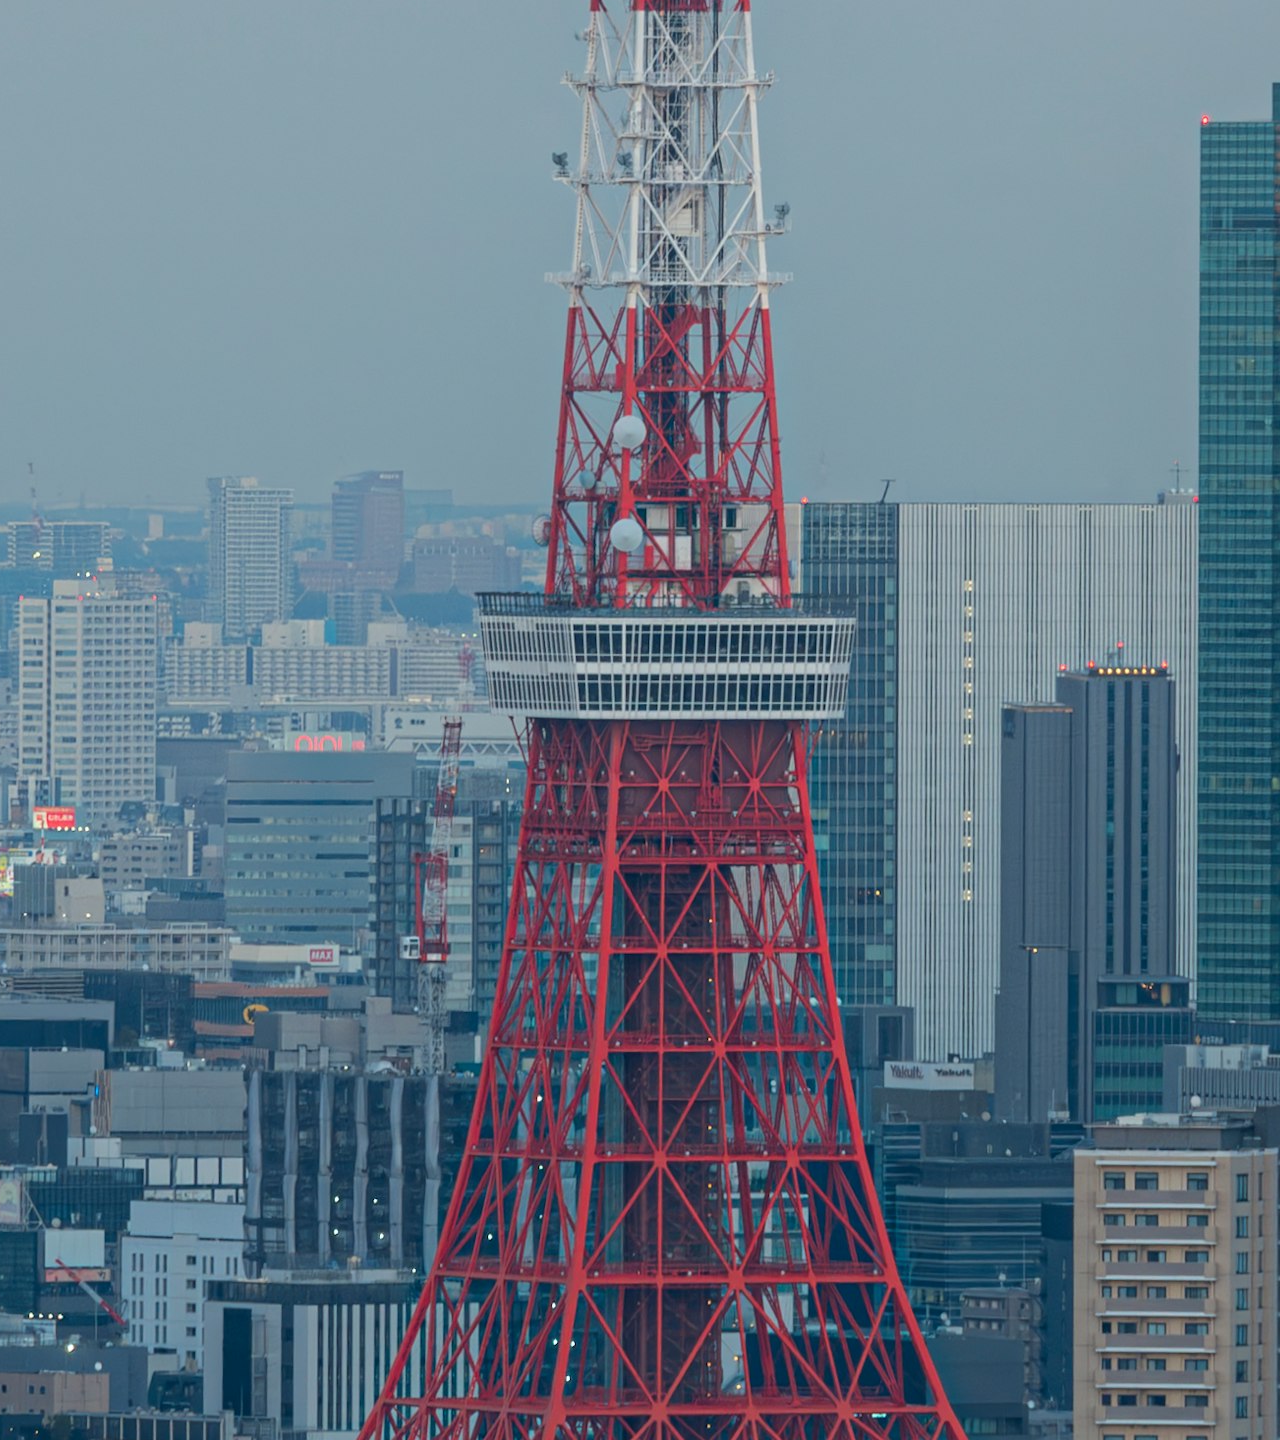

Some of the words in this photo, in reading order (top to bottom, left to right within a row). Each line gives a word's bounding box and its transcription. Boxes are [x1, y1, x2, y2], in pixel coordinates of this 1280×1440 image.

[311, 950, 333, 961] MAX
[890, 1064, 924, 1080] Yakult
[934, 1068, 972, 1077] Yakult
